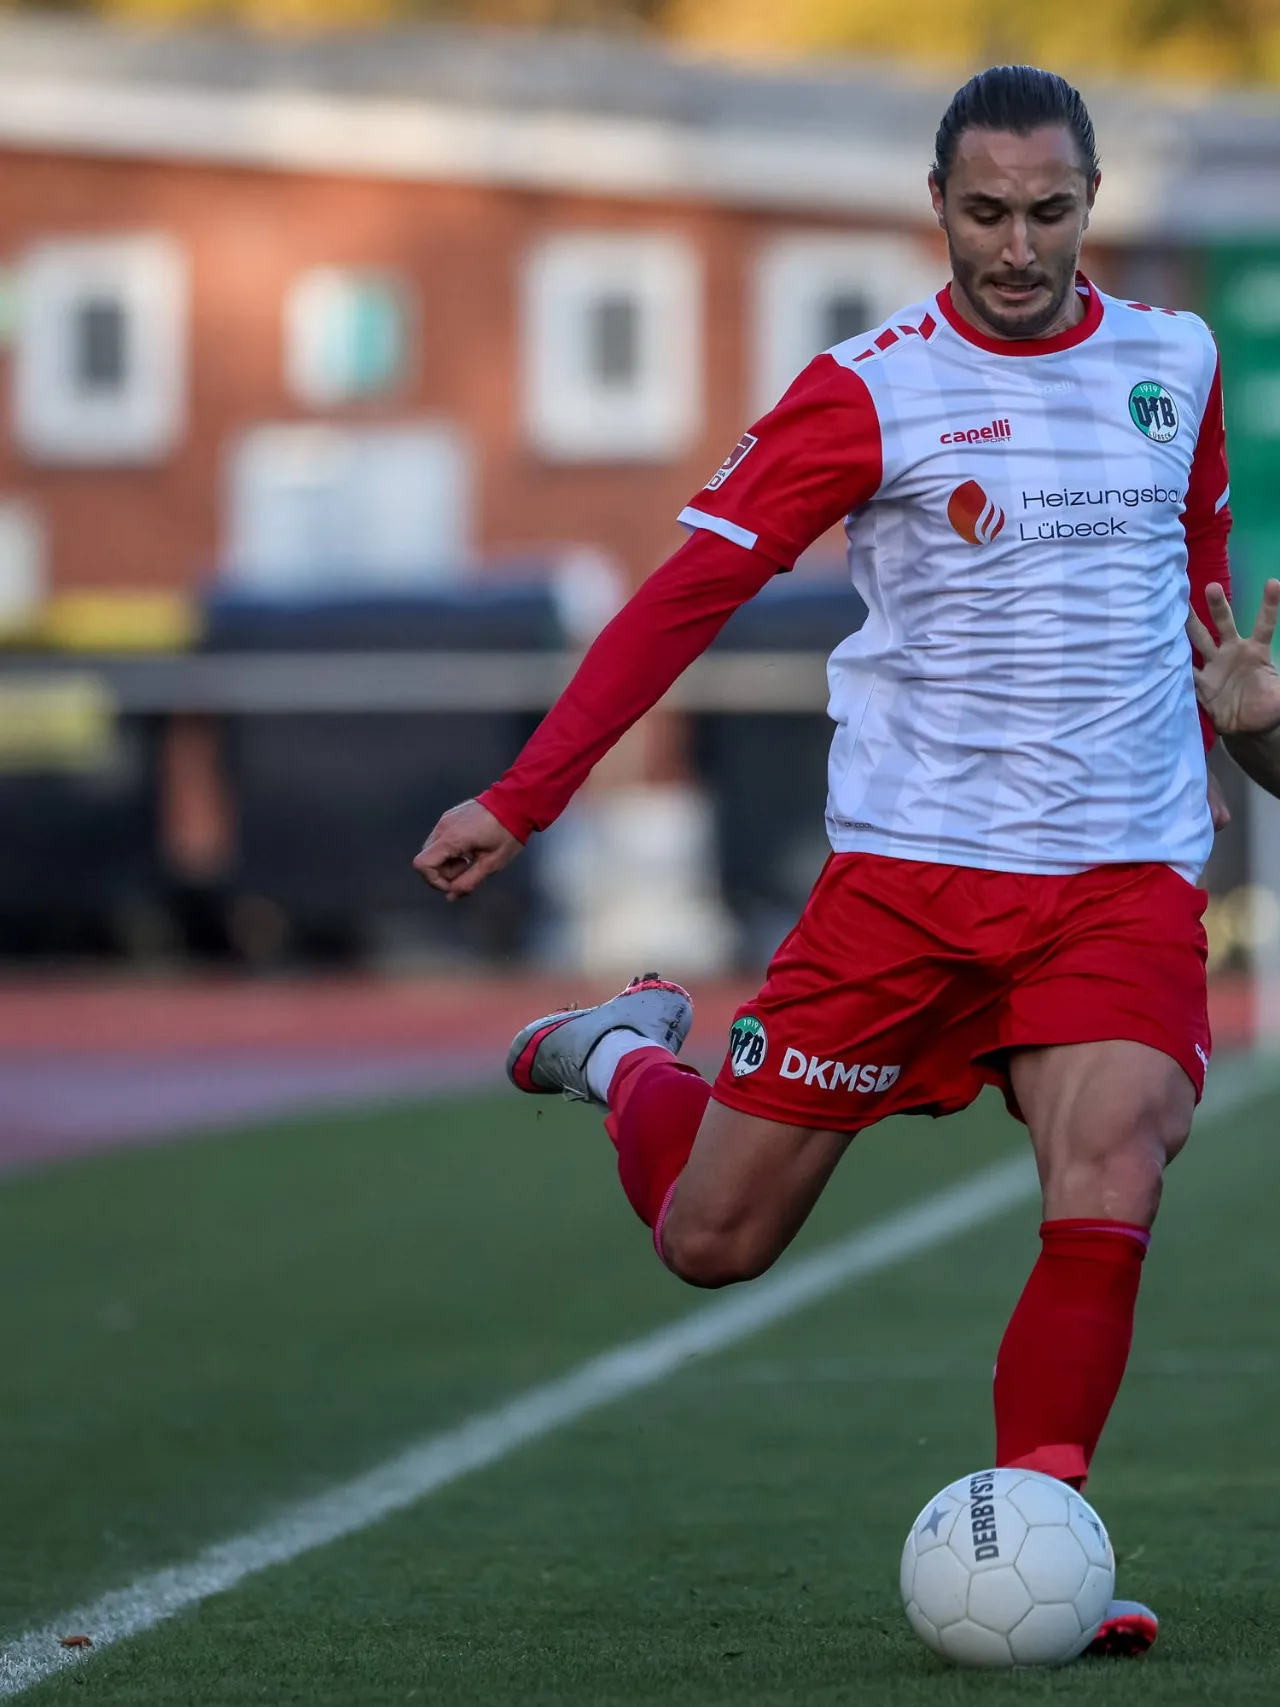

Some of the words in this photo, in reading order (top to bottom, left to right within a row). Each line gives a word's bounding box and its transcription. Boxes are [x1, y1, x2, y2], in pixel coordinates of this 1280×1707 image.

[1140, 384, 1158, 393] 1919
[939, 418, 1012, 445] capelli
[975, 436, 1012, 445] SPORT
[1019, 516, 1128, 542] Lübeck
[743, 1018, 759, 1029] 1919
[779, 1047, 877, 1094] DKMS
[970, 1470, 999, 1562] DERBYSTA
